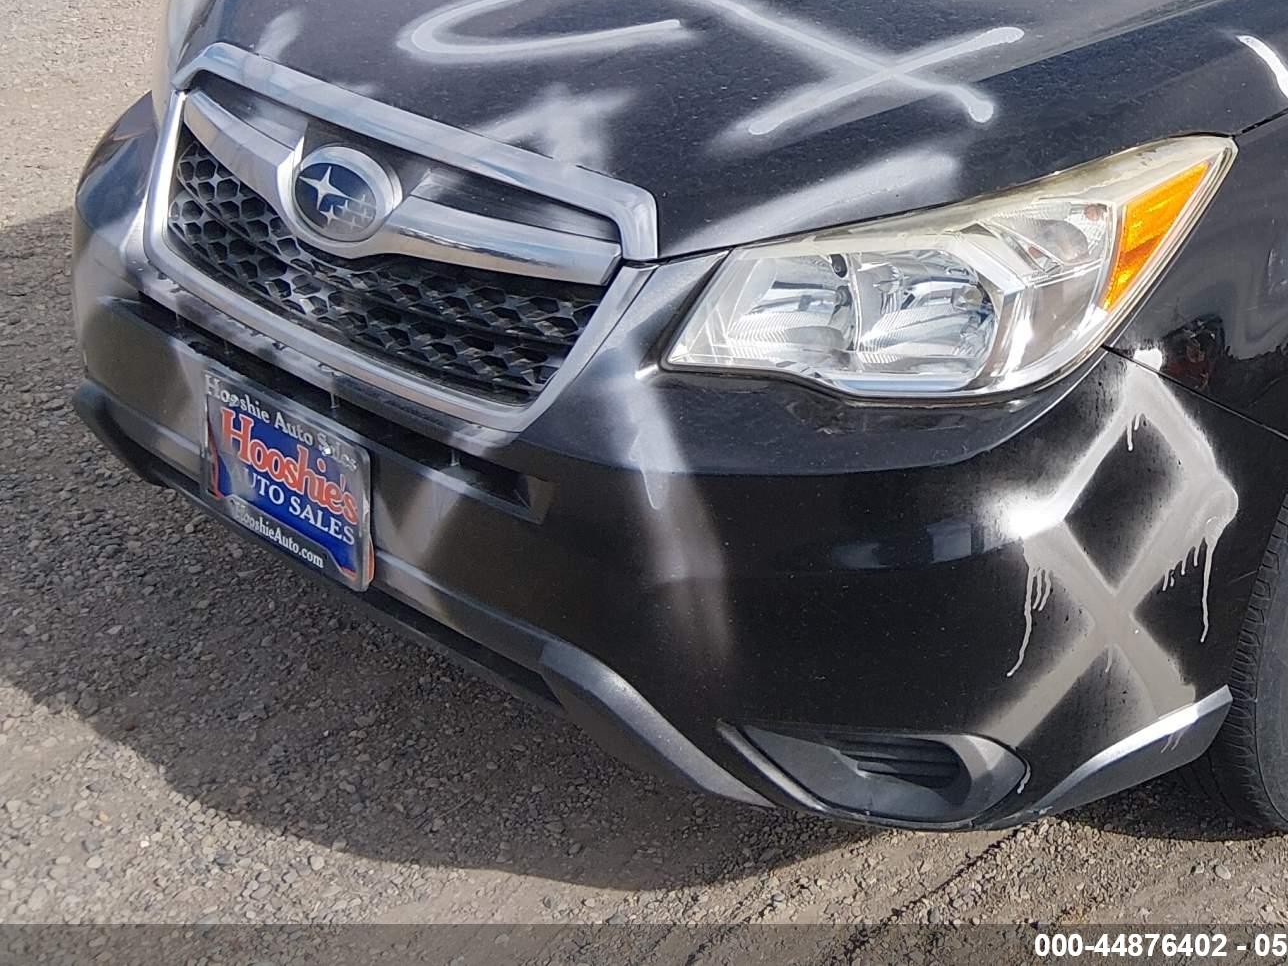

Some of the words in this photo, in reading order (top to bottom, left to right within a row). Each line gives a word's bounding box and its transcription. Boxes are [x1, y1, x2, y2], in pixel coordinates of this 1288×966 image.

[274, 411, 315, 446] Auto
[220, 406, 358, 525] Hooshie's
[231, 500, 324, 569] HooshieAuto.com
[288, 496, 355, 546] SALES
